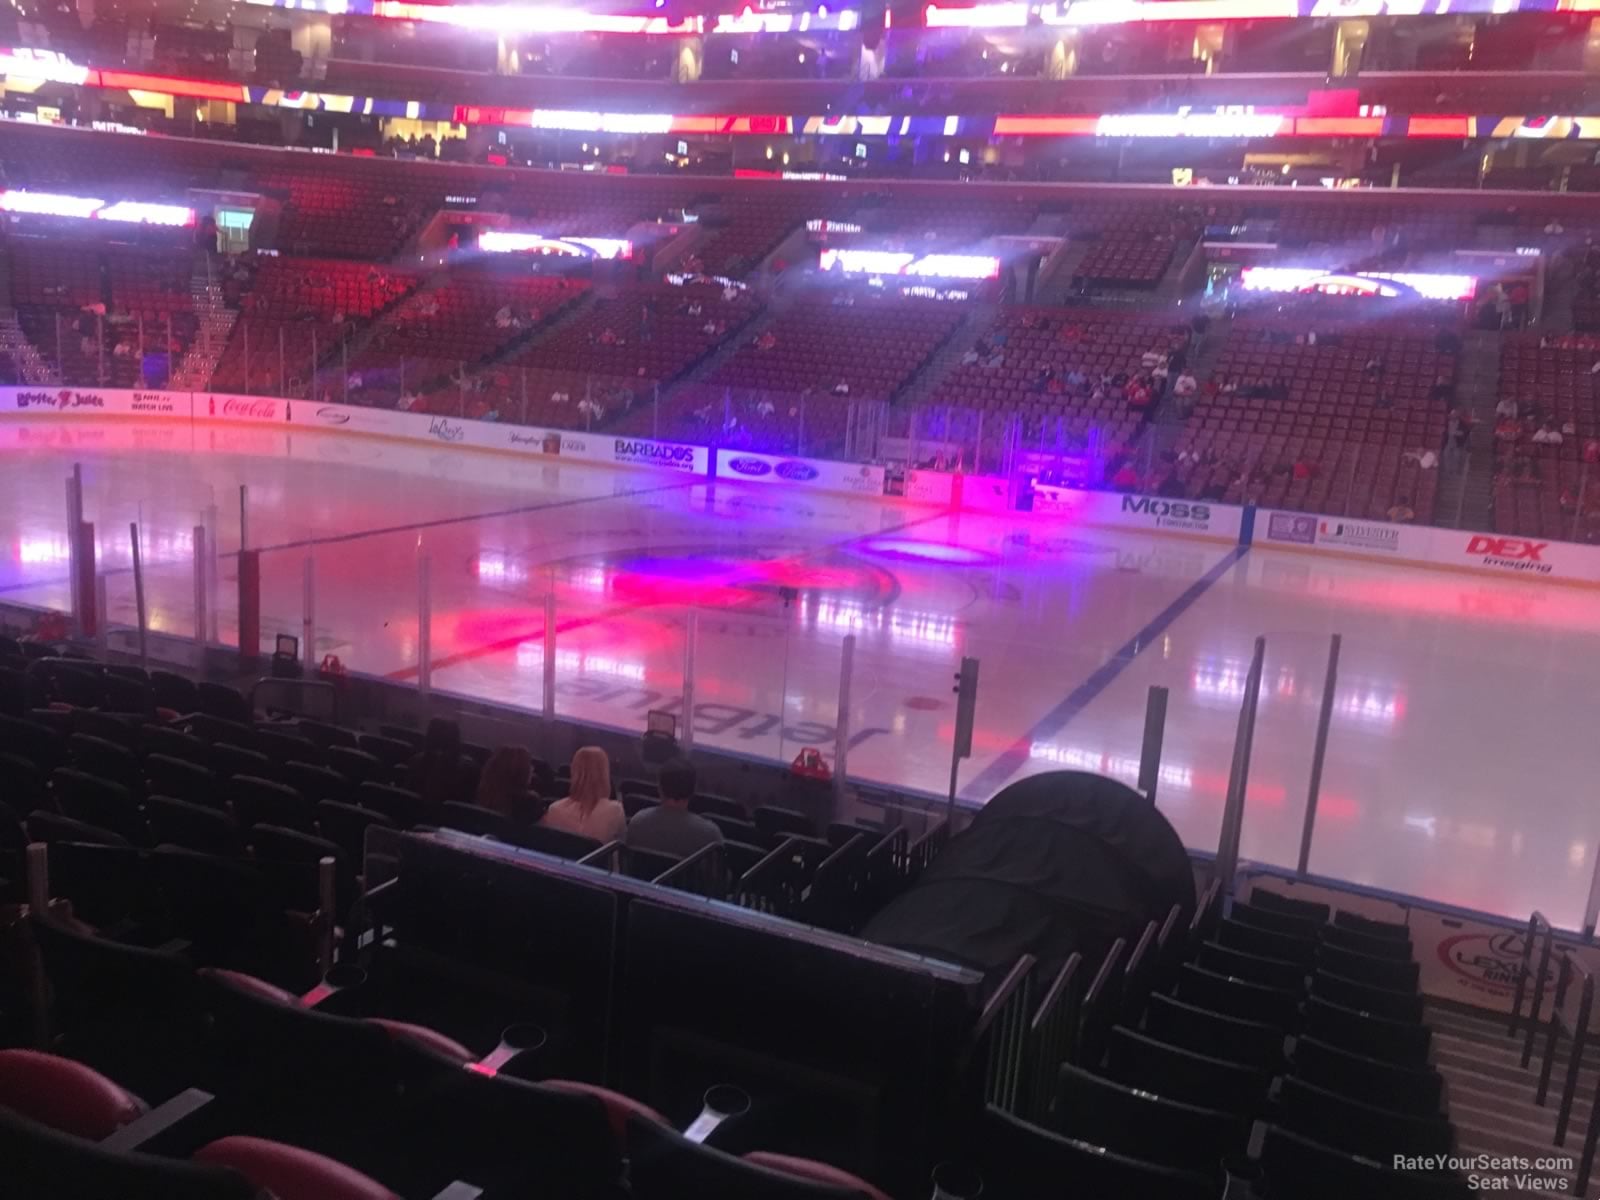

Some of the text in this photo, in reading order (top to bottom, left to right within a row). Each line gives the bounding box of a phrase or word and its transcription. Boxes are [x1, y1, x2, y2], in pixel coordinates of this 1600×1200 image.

[615, 439, 694, 462] BARBADOS
[735, 459, 763, 473] Ford
[1466, 536, 1548, 561] DEX
